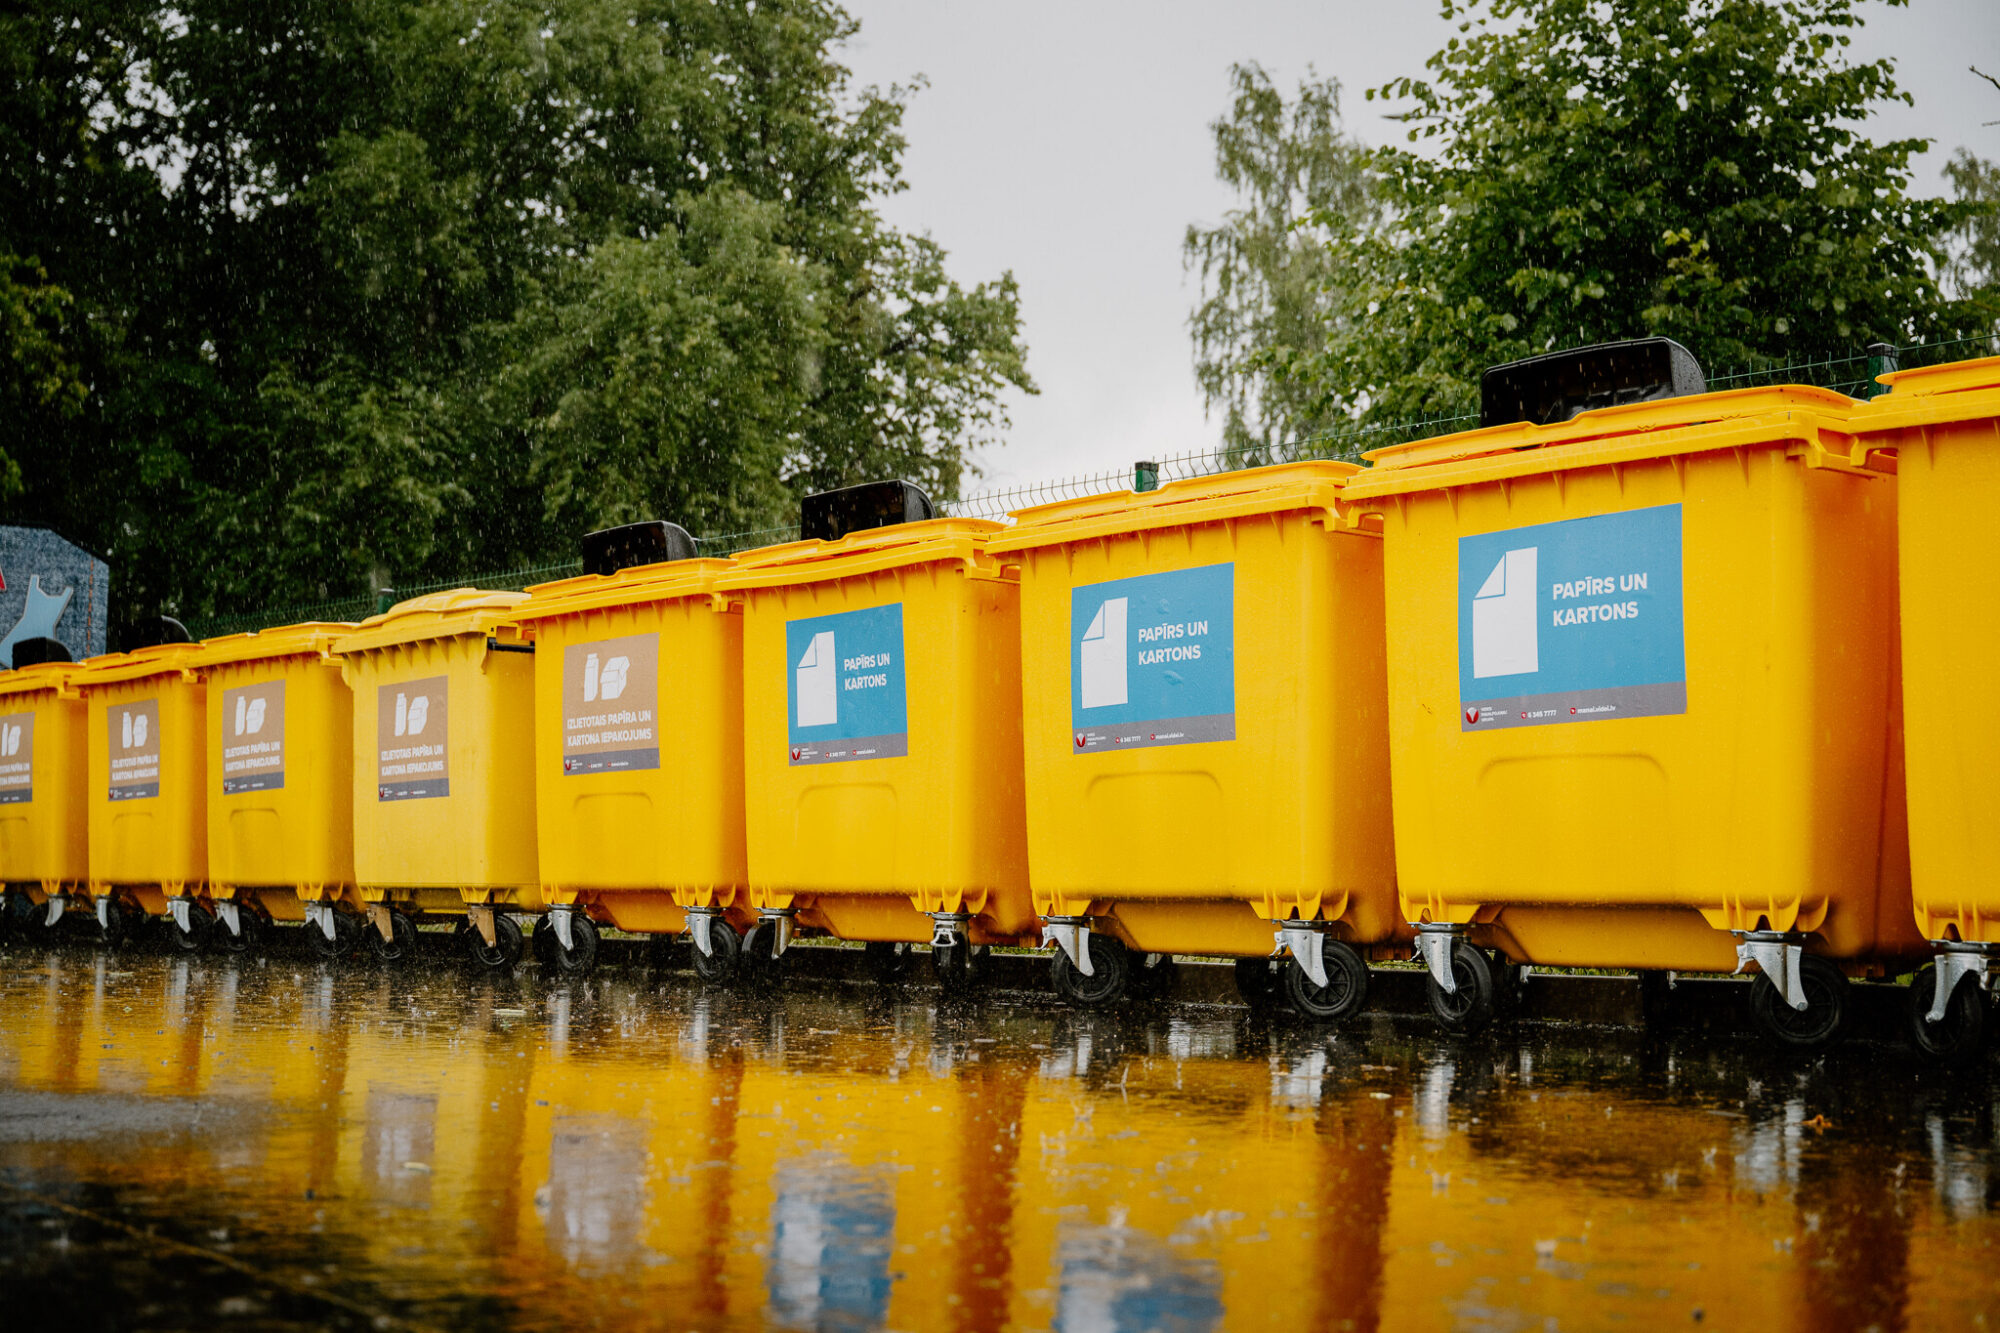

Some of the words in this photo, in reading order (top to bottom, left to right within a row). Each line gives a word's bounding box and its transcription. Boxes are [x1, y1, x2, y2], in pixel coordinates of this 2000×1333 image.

[1553, 576, 1615, 600] PAPĪRS
[1620, 573, 1648, 592] UN
[1553, 601, 1639, 627] KARTONS
[1138, 623, 1184, 643] PAPĪRS
[1187, 620, 1208, 637] UN
[844, 654, 875, 671] PAPĪRS
[877, 653, 890, 667] UN
[1138, 645, 1201, 665] KARTONS
[844, 674, 887, 691] KARTONS
[608, 710, 637, 725] PAPĪRA
[638, 710, 651, 722] UN
[567, 732, 600, 747] KARTONA
[601, 728, 652, 744] IEPAKOJUMS
